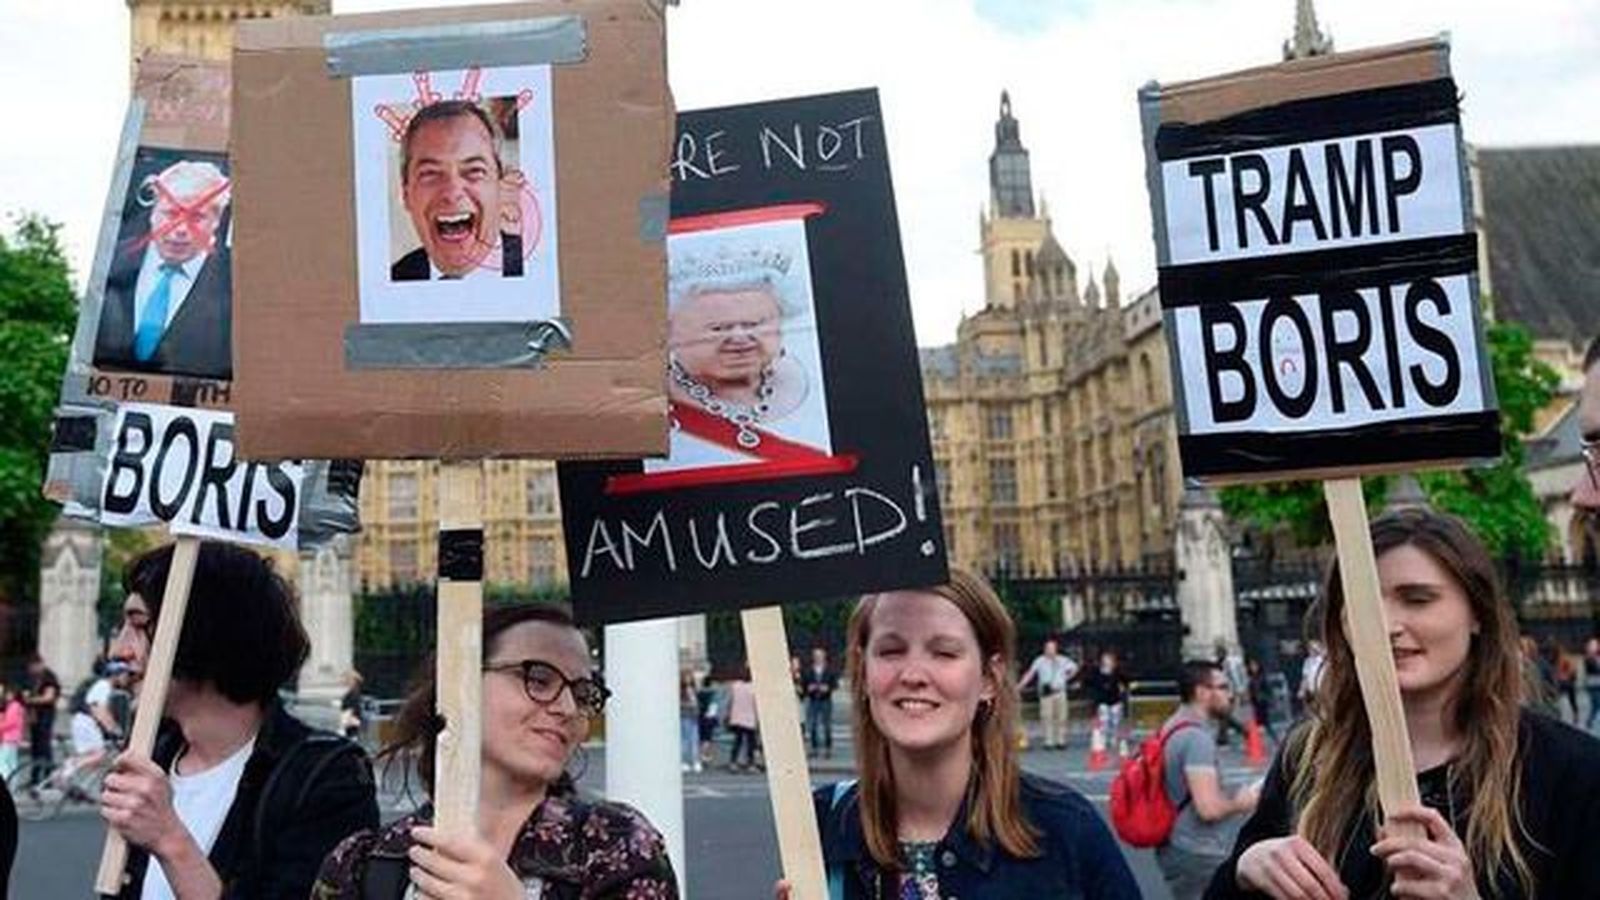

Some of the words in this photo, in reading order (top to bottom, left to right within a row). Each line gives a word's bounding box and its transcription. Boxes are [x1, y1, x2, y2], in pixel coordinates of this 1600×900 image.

[671, 130, 741, 180] RE
[759, 115, 874, 170] NOT
[1188, 134, 1423, 252] TRAMP
[118, 377, 148, 399] TO
[1199, 279, 1461, 423] BORIS
[104, 412, 296, 539] BORIS
[578, 464, 935, 578] AMUSED!
